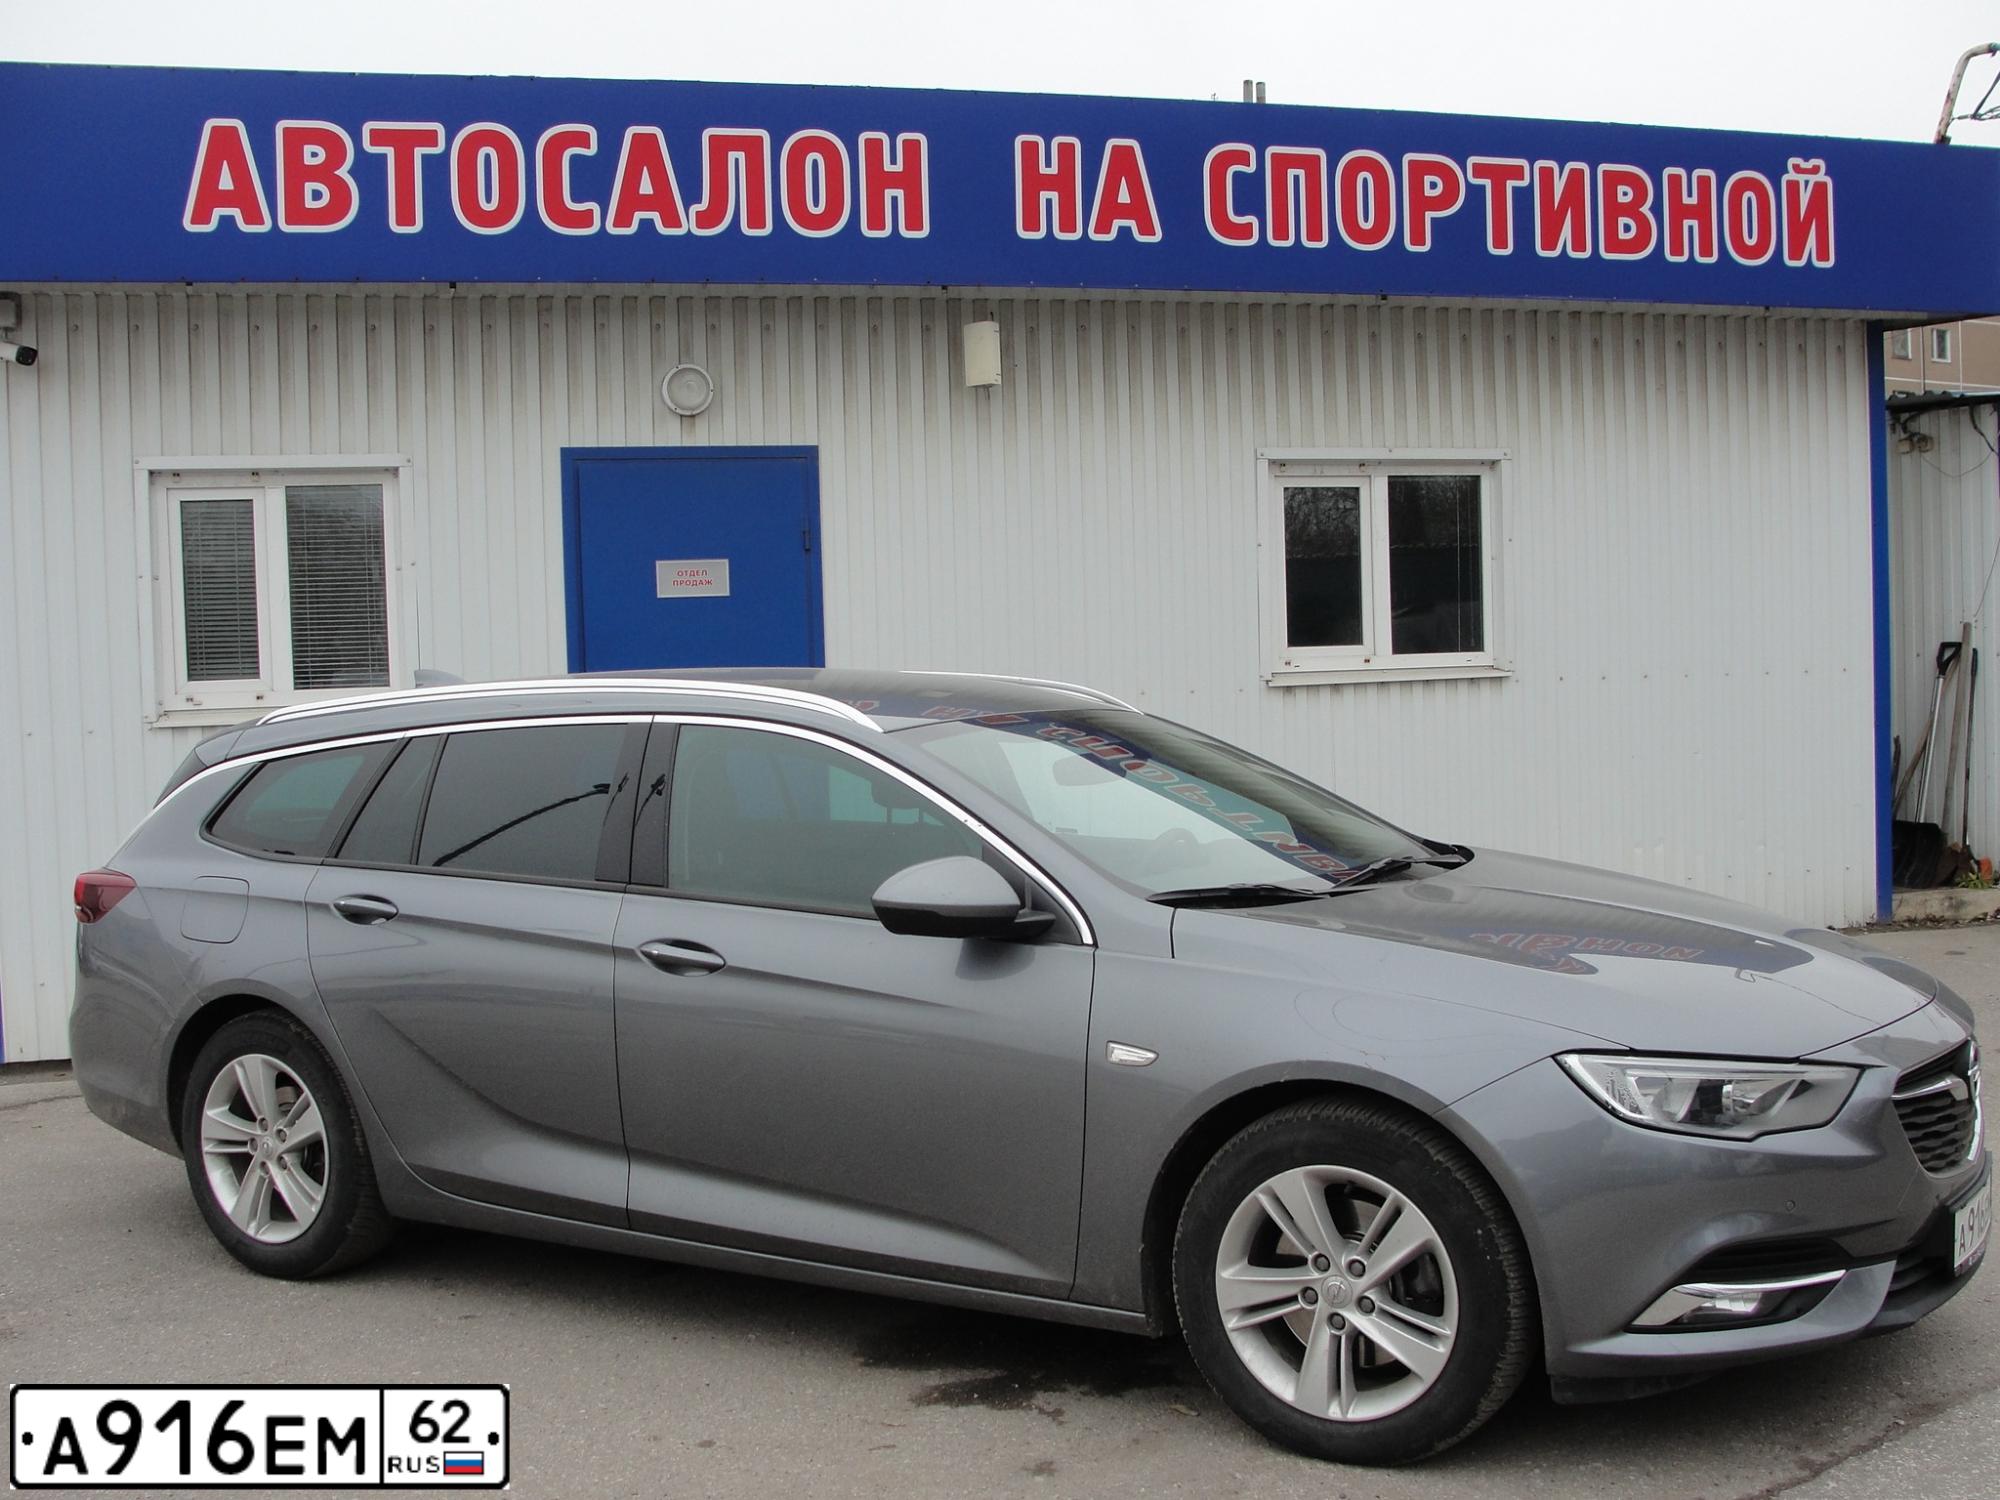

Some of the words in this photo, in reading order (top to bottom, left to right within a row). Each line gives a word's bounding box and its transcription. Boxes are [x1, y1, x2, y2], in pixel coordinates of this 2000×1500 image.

[182, 117, 931, 240] АВТОСАЛОН
[1014, 133, 1163, 243] НА
[1202, 141, 1836, 269] СПОРТИВНОЙ
[677, 569, 708, 577] ОТДЕЛ
[672, 579, 713, 587] ПРОДАЖ
